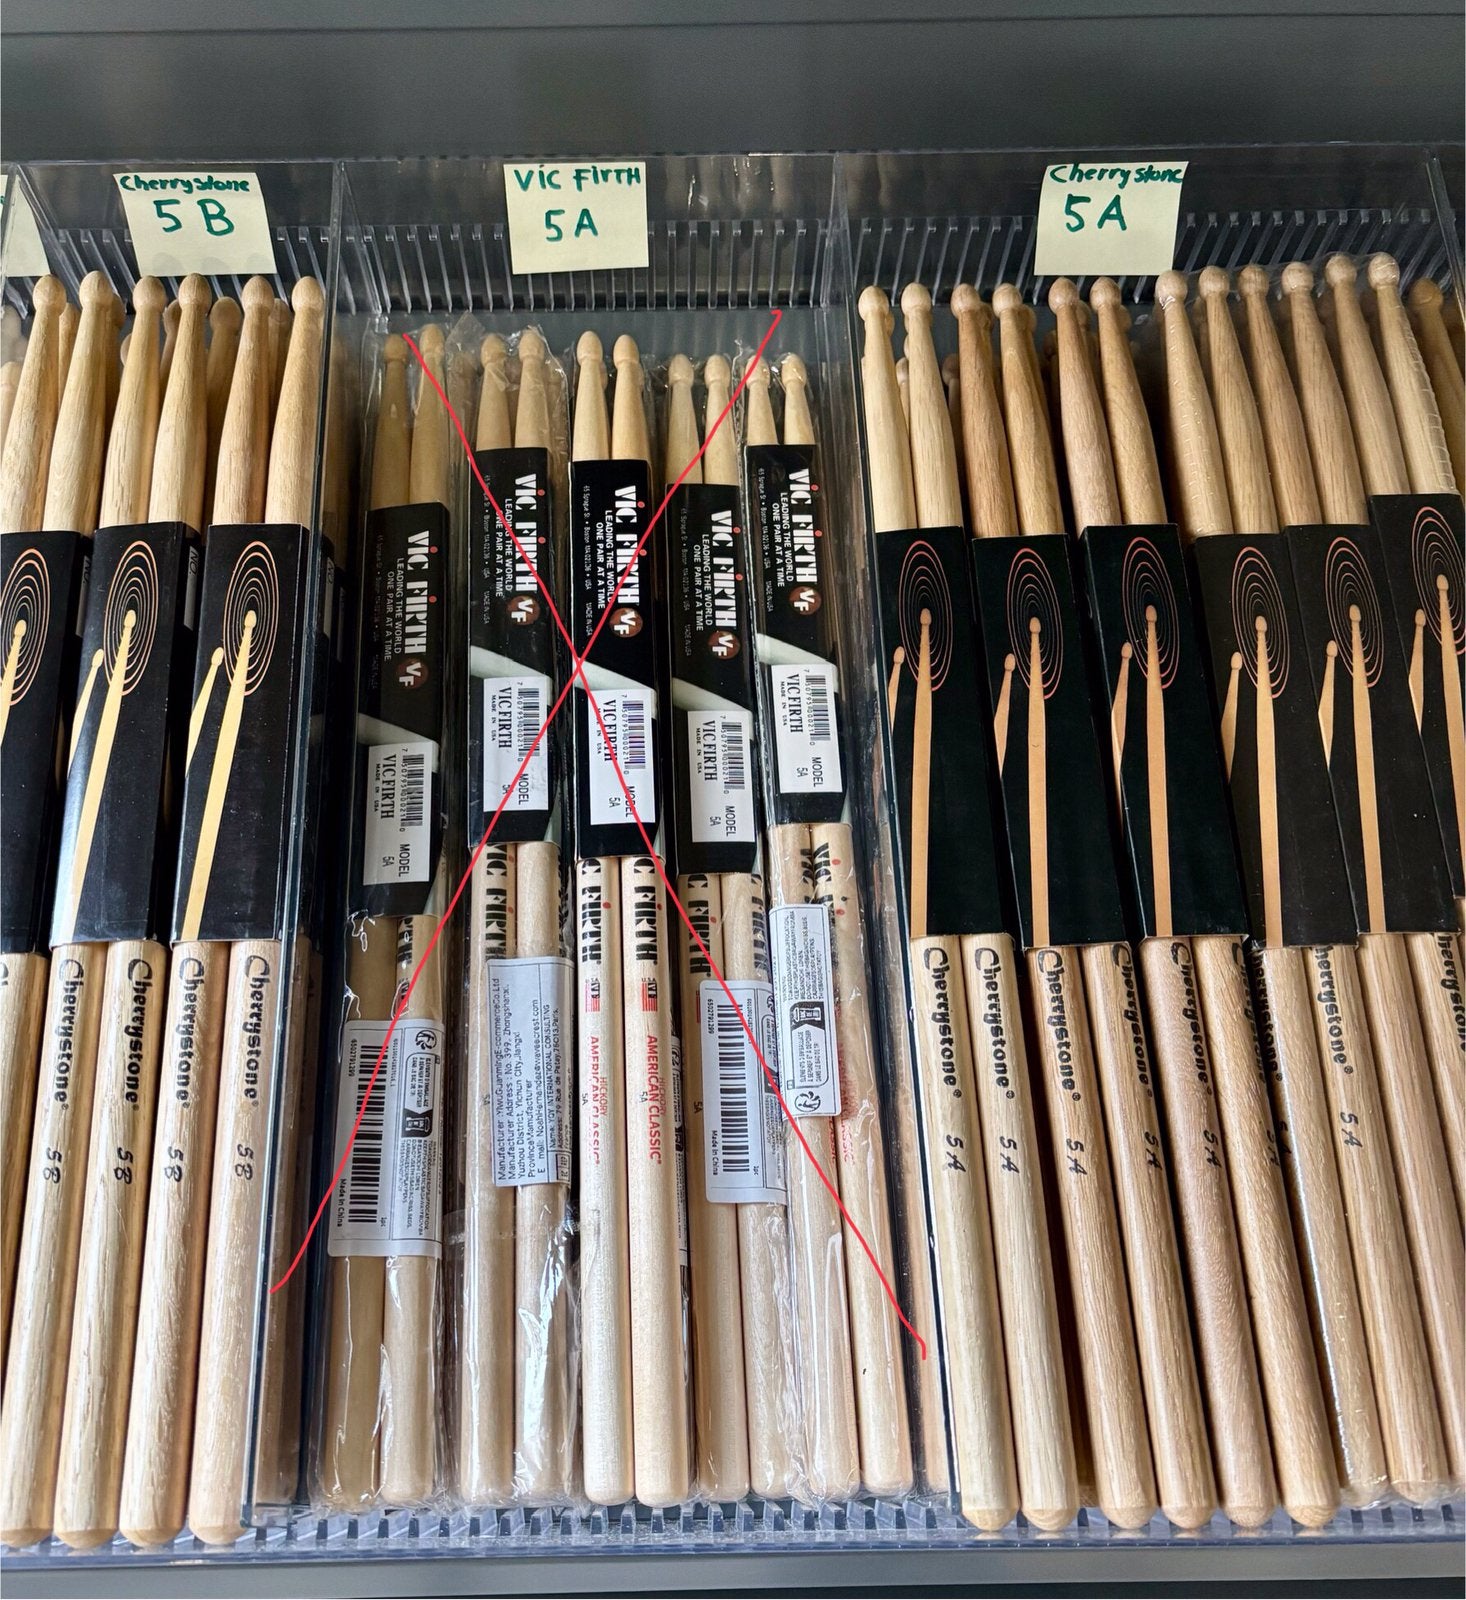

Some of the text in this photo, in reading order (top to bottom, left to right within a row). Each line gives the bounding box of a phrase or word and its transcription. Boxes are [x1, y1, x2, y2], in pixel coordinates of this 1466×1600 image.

[495, 511, 503, 529] ONE
[772, 503, 780, 521] ONE
[596, 522, 604, 540] ONE
[774, 524, 782, 542] PAIR
[780, 492, 794, 582] LEADING THE WORLD
[495, 532, 503, 551] PAIR
[505, 499, 513, 591] LEADING THE WORLD
[774, 546, 782, 557] AT
[495, 554, 503, 565] AT
[596, 544, 604, 562] PAIR
[605, 510, 615, 603] LEADING THE WORLD
[693, 544, 701, 562] ONE
[702, 534, 711, 572] LEADING
[597, 566, 605, 577] AT
[694, 566, 702, 585] PAIR
[777, 567, 785, 587] TIME
[495, 576, 503, 597] TIME
[695, 588, 703, 599] AT
[386, 593, 394, 613] PAIR
[394, 557, 404, 654] LEADING THE WORLD
[597, 588, 606, 609] TIME
[704, 593, 713, 625] WORLD
[385, 617, 393, 628] AT
[696, 610, 704, 631] TIME
[384, 640, 392, 660] TIME
[603, 700, 617, 721] VIC
[787, 674, 803, 733] VIC FIRTH
[498, 687, 512, 748] VIC FIRTH
[703, 720, 717, 780] VIC FIRTH
[797, 768, 808, 778] 5A
[812, 757, 823, 787] MODEL
[375, 786, 380, 794] IN
[381, 754, 397, 819] VIC FIRTH
[609, 797, 620, 808] 5A
[710, 816, 721, 827] 5A
[725, 806, 736, 837] MODEL
[382, 856, 395, 868] 5A
[399, 843, 410, 878] MODEL
[590, 1036, 600, 1101] AMERICAN
[648, 1035, 659, 1101] AMERICAN
[600, 1077, 608, 1116] HICKORY
[640, 1091, 648, 1103] 5A
[693, 1101, 703, 1114] 5A
